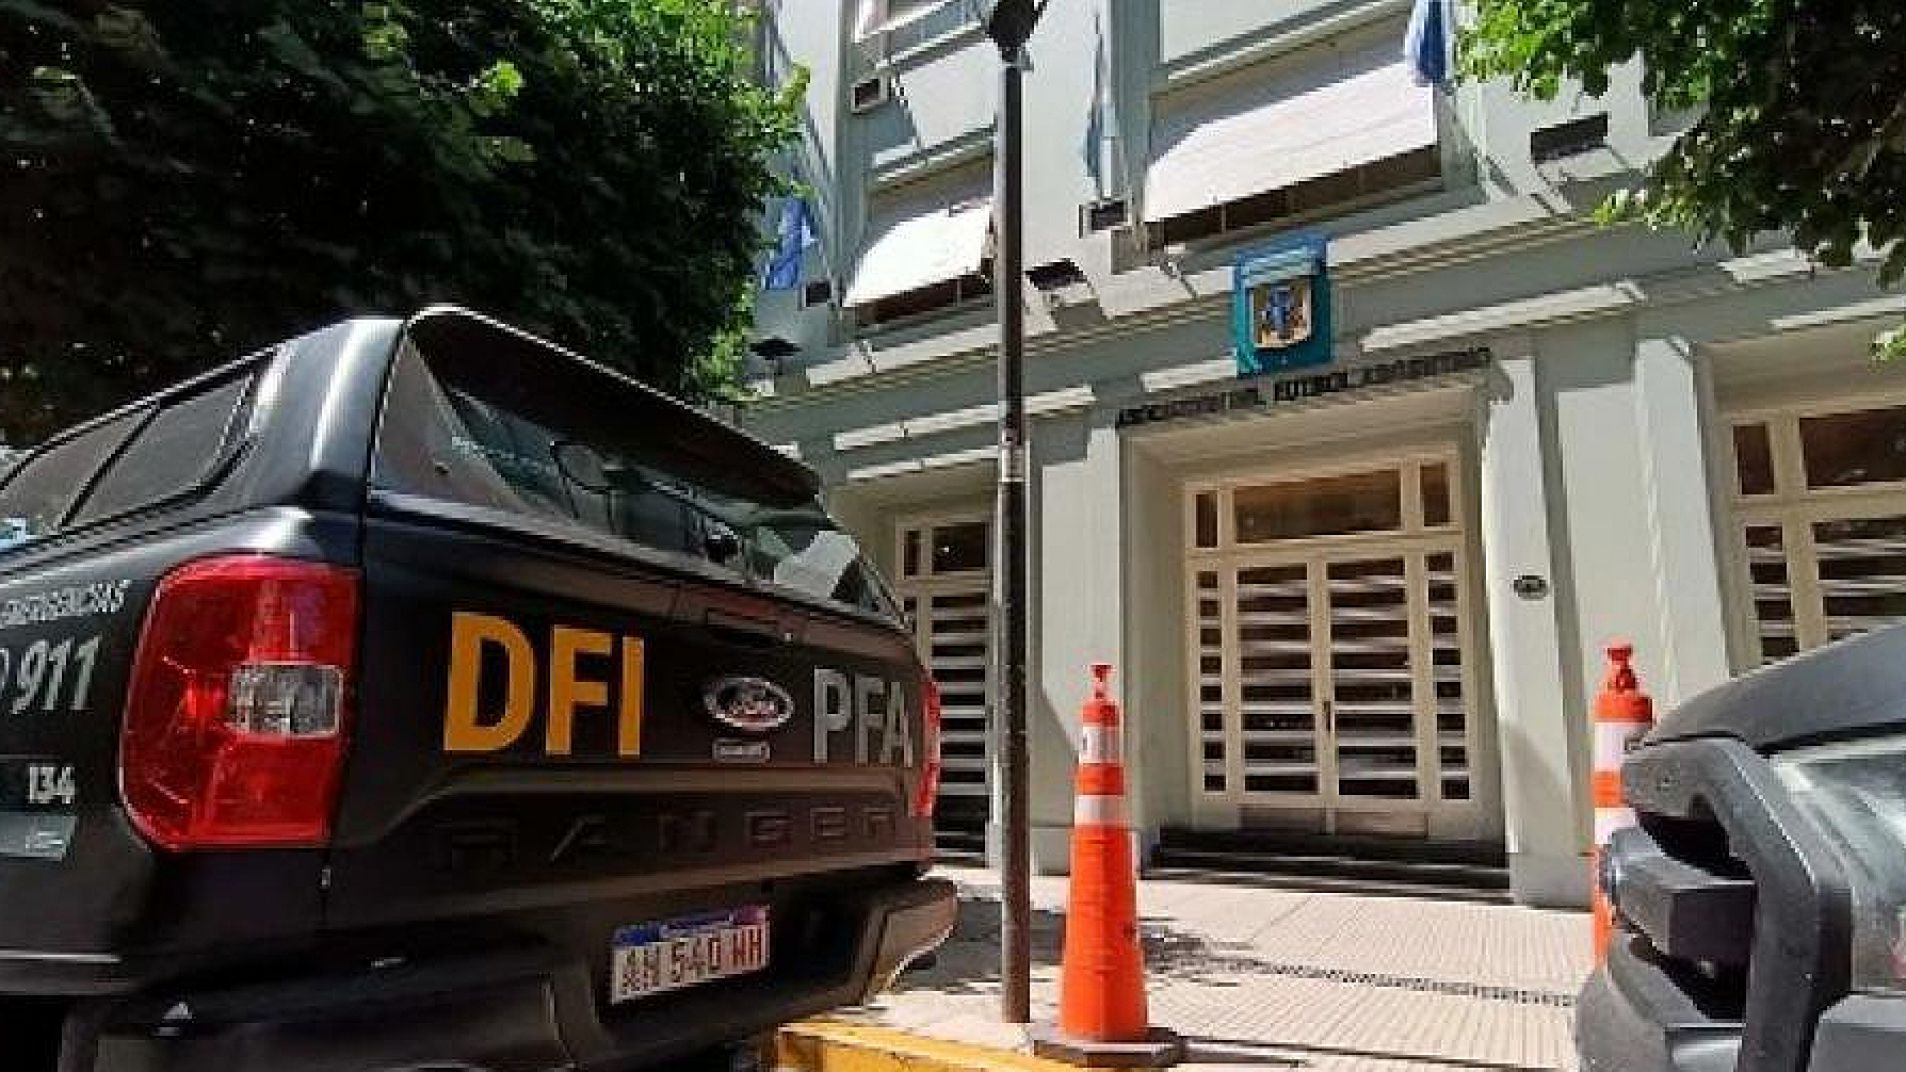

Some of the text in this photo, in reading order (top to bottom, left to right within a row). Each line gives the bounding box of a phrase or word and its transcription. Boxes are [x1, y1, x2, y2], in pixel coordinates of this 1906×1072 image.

[11, 633, 101, 714] 911
[443, 611, 645, 757] DFI
[812, 668, 913, 767] PFA
[28, 766, 76, 804] 134
